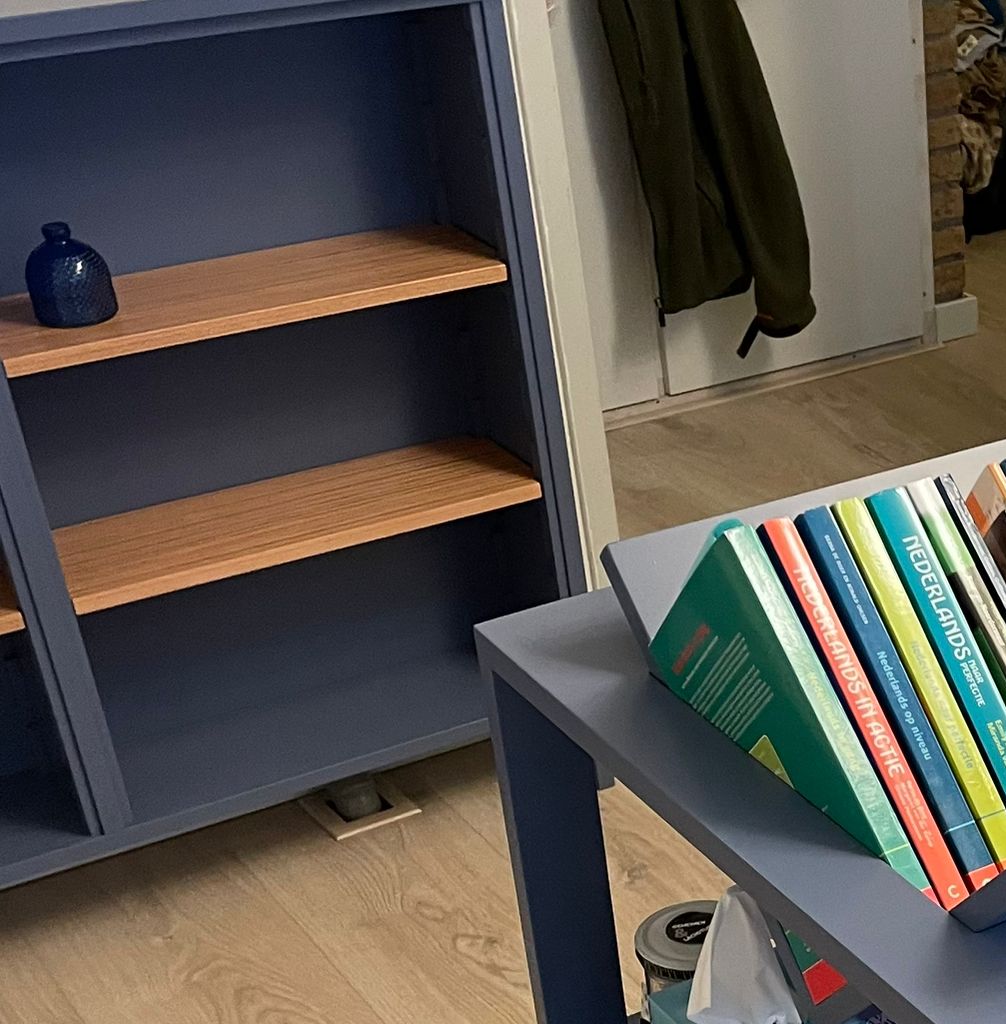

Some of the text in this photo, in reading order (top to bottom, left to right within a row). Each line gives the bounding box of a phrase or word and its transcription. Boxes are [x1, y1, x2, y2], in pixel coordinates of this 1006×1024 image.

[898, 532, 975, 661] NEDERLANDS
[790, 563, 906, 779] NEDERLANDS IN ACTIE
[875, 649, 910, 709] Nederlands
[901, 710, 915, 726] op
[910, 724, 933, 761] niveau
[957, 661, 986, 708] PERFECTIE
